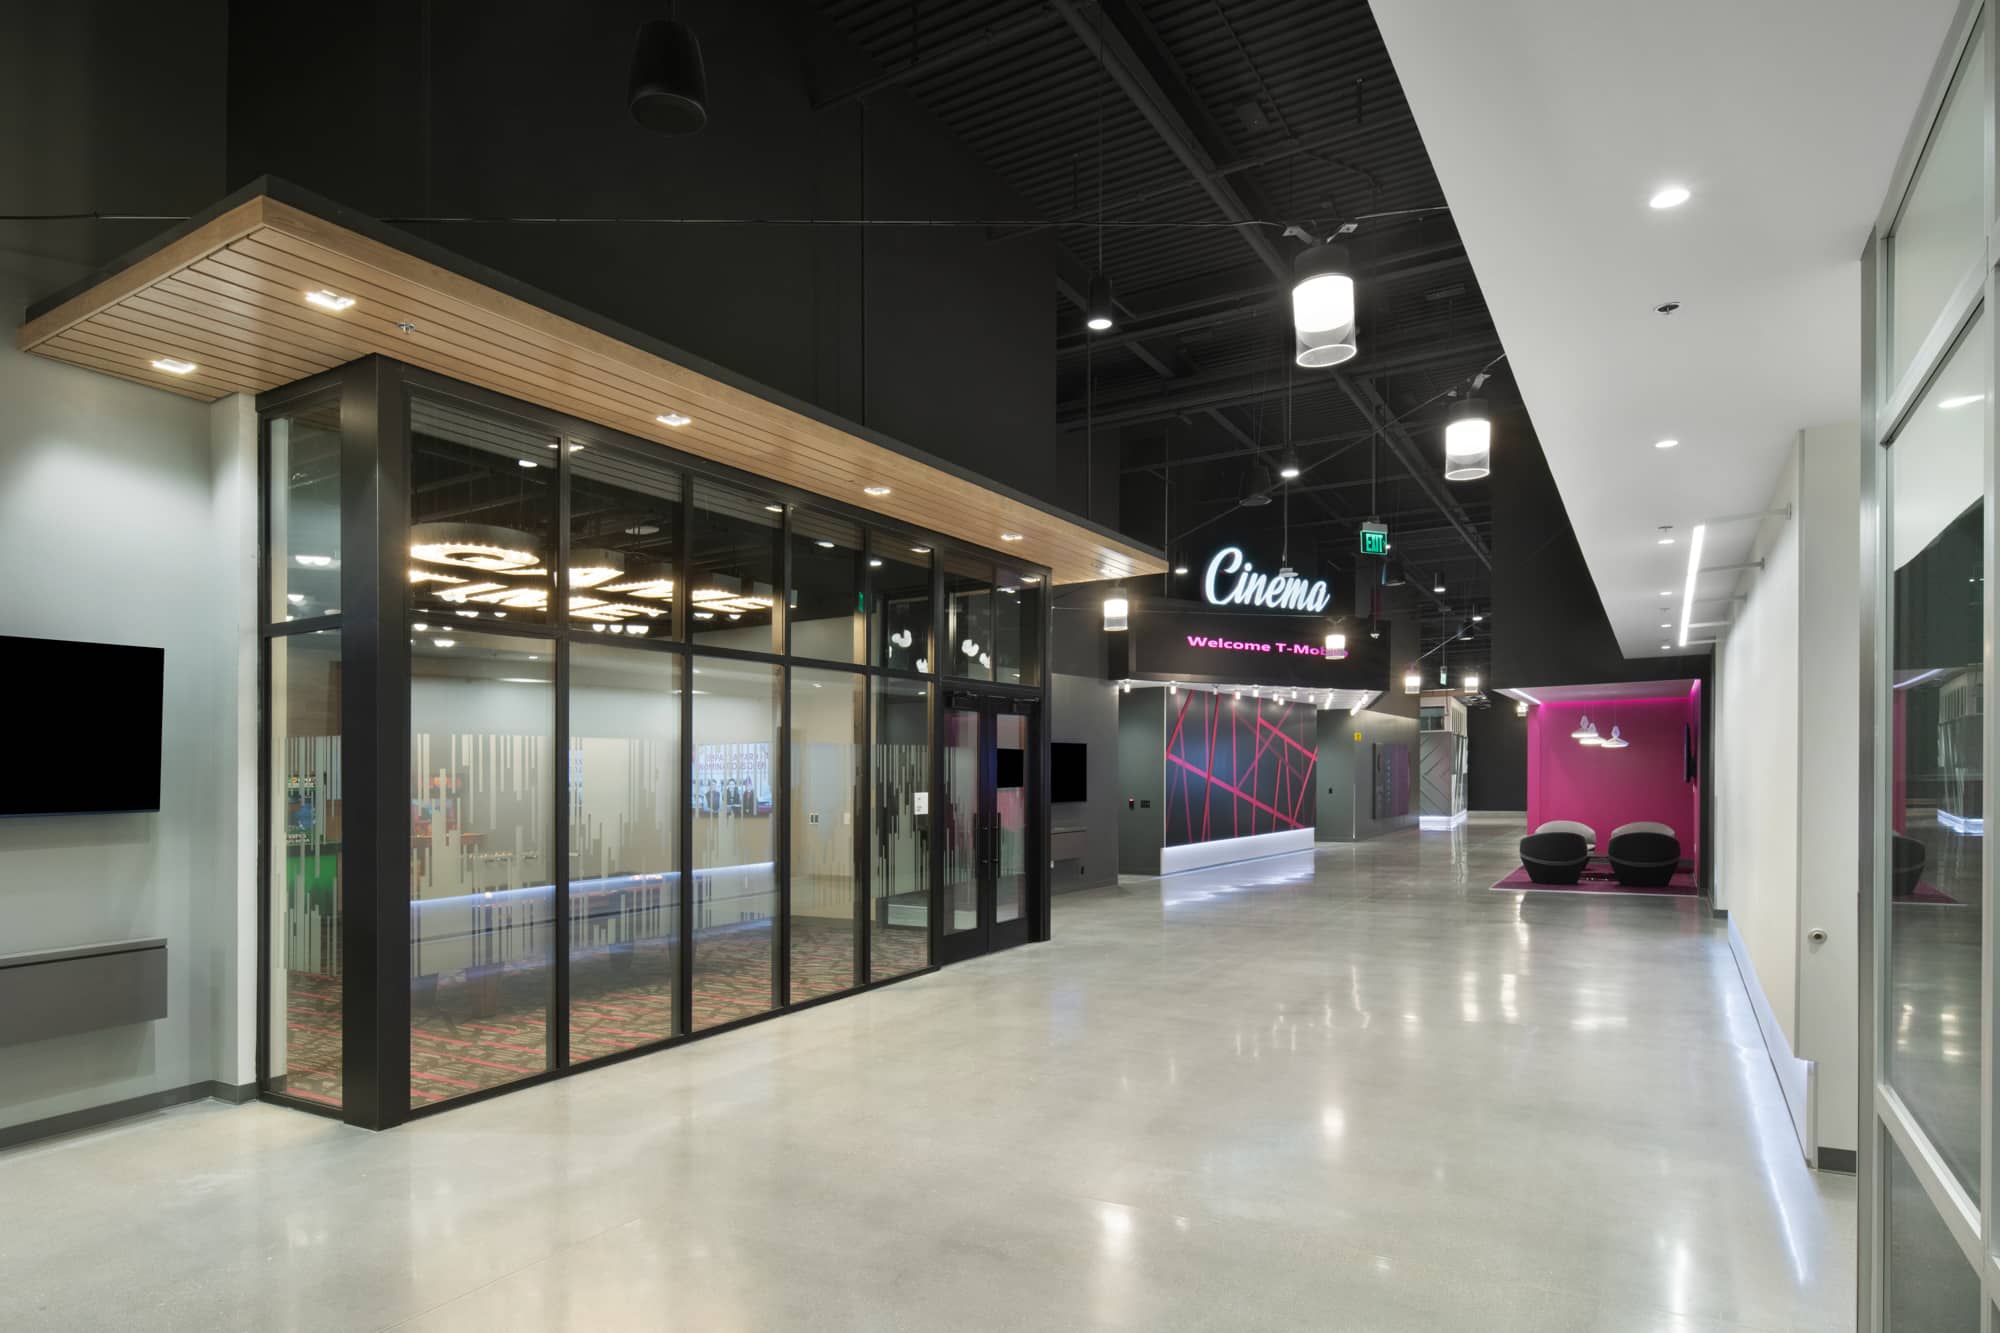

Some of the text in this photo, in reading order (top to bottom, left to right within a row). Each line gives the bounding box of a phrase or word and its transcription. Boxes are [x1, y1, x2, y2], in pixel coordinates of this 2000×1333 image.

[1366, 533, 1384, 552] EXIT
[1205, 546, 1331, 613] Cinema
[1187, 635, 1349, 658] Welcome T-Mob
